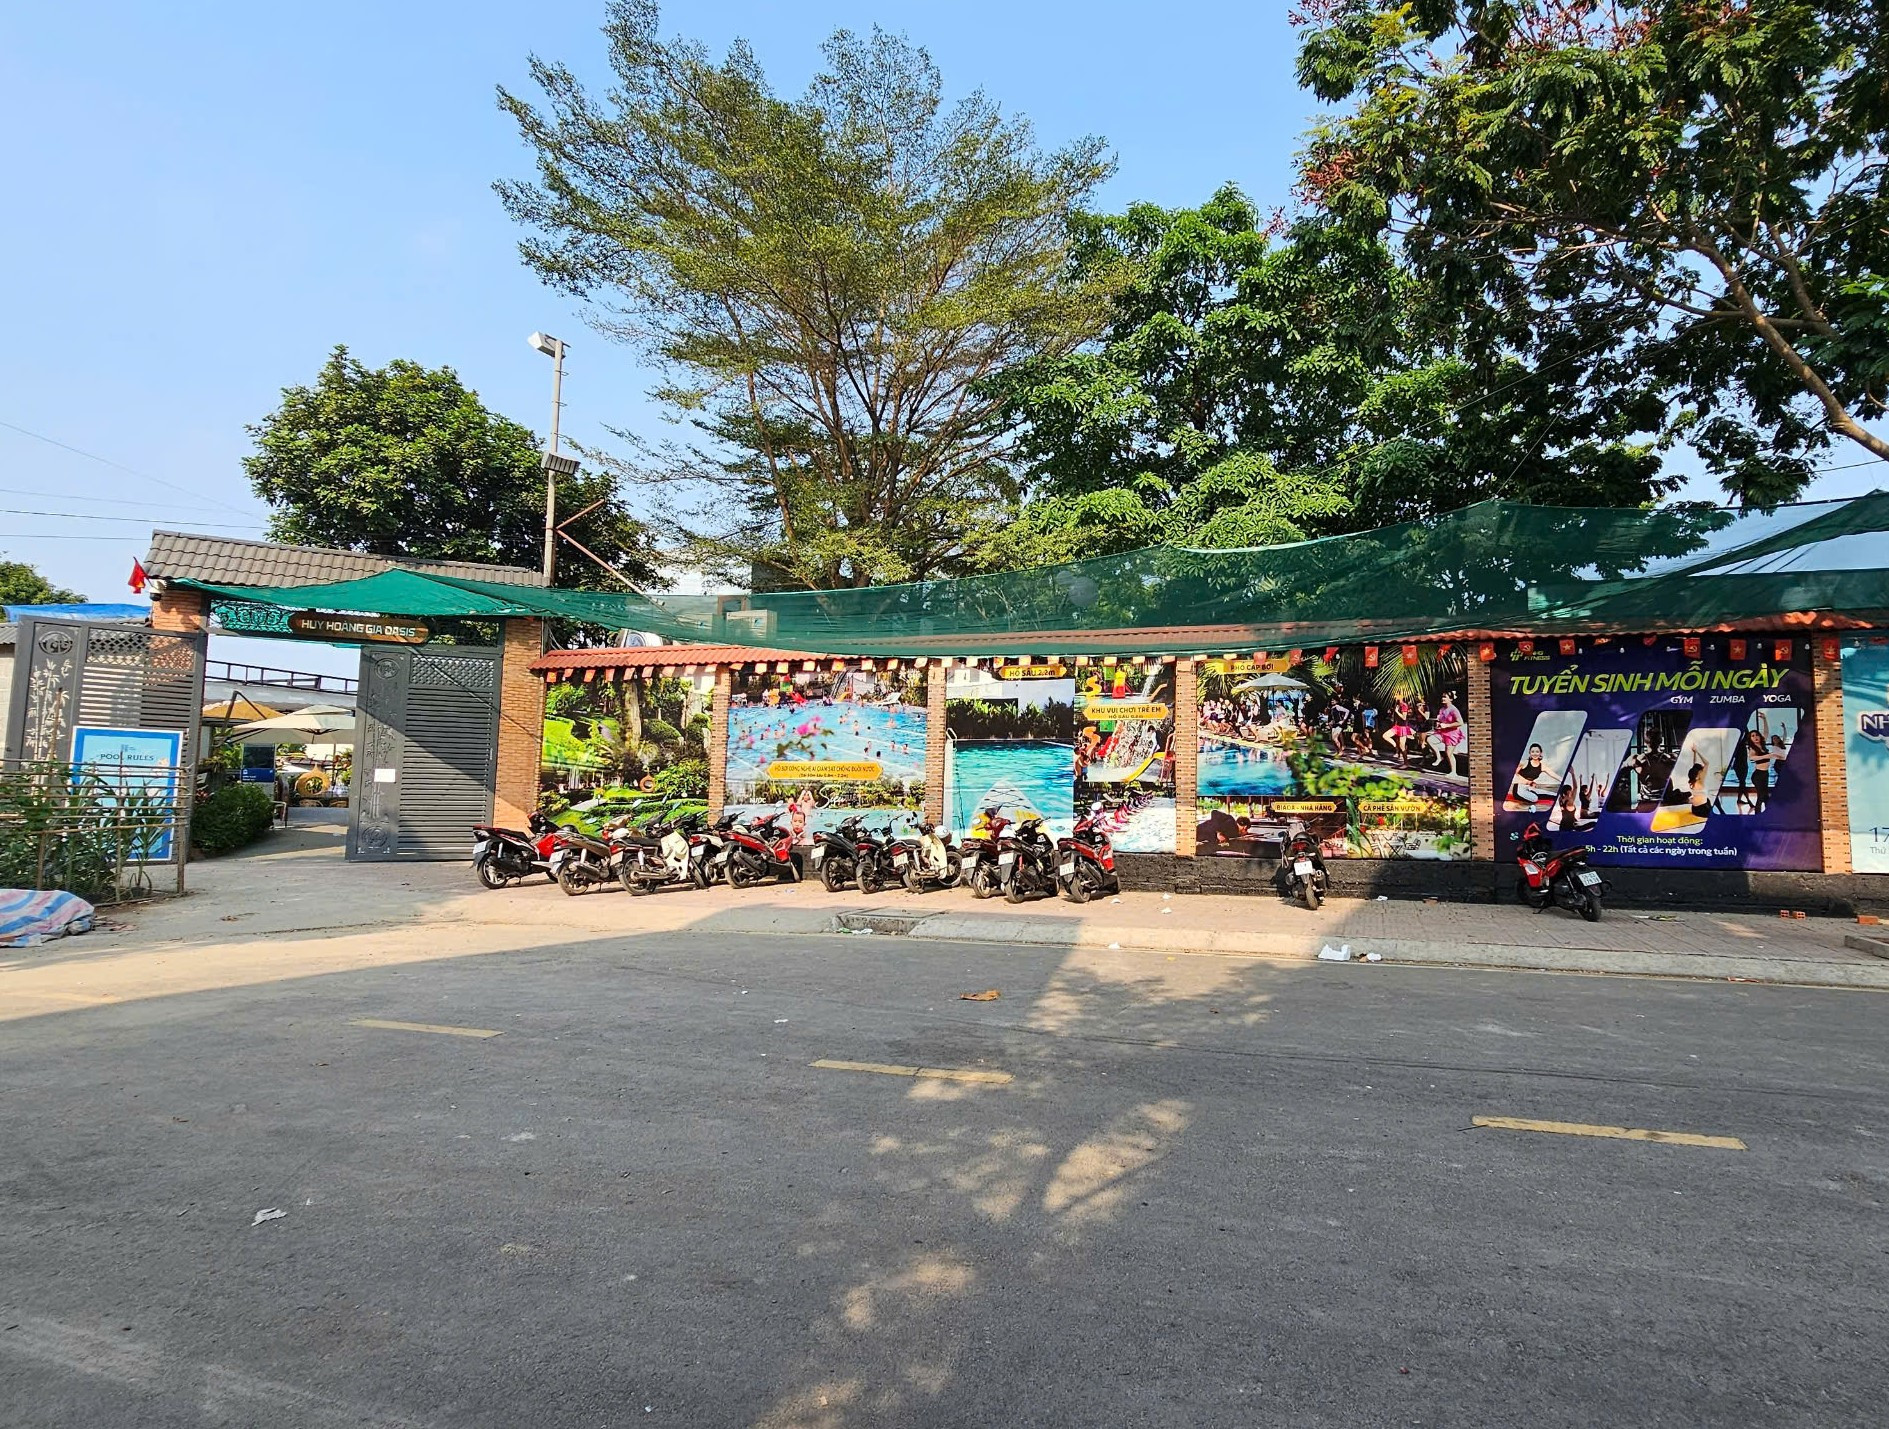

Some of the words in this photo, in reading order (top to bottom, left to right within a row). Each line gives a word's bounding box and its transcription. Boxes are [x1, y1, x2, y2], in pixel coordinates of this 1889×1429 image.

[301, 619, 324, 630] HUY
[326, 620, 364, 633] HOÀNG
[365, 624, 383, 634] GIA
[384, 625, 416, 637] OASIS
[1022, 667, 1037, 677] SÂU
[1510, 664, 1590, 695] TUYỂN
[1591, 672, 1654, 693] SINH
[1654, 660, 1710, 692] MỖI
[1711, 662, 1790, 690] NGÀY
[1670, 694, 1694, 704] GYM
[1709, 695, 1746, 704] ZUMBA
[1762, 694, 1792, 703] YOGA
[127, 753, 155, 761] RULES
[1372, 803, 1385, 811] PHÊ
[1868, 827, 1889, 843] 17
[1616, 835, 1635, 843] Thời
[1636, 836, 1655, 845] gian
[1656, 836, 1676, 846] hoạt
[1677, 836, 1703, 847] động:
[1602, 845, 1619, 853] 22h
[1620, 845, 1637, 854] (Tất
[1637, 845, 1648, 854] cả
[1649, 846, 1663, 854] các
[1665, 847, 1687, 856] ngày
[1687, 847, 1712, 856] trong
